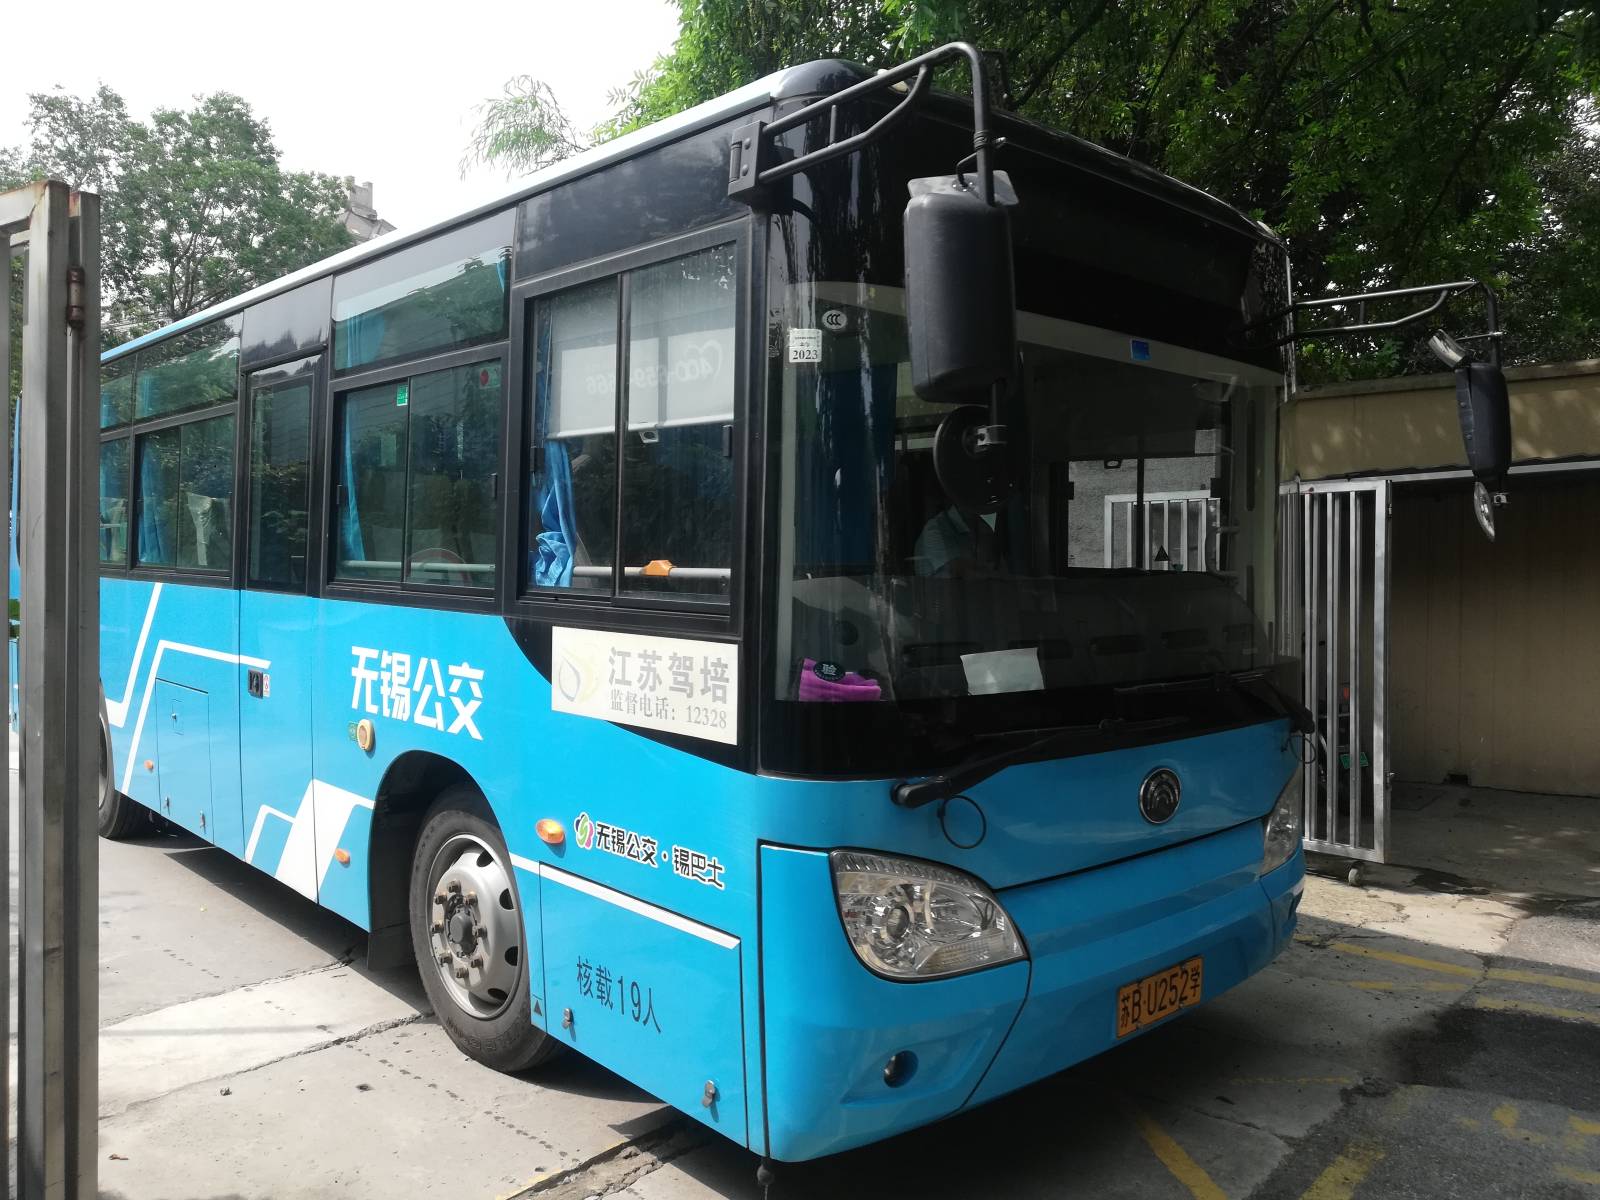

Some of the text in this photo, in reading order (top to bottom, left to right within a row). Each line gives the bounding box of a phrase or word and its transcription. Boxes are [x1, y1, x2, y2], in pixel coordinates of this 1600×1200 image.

[792, 349, 818, 360] 2023
[351, 645, 485, 741] 无锡公交
[608, 646, 730, 704] 江苏驾培
[576, 955, 661, 1033] 核载19人
